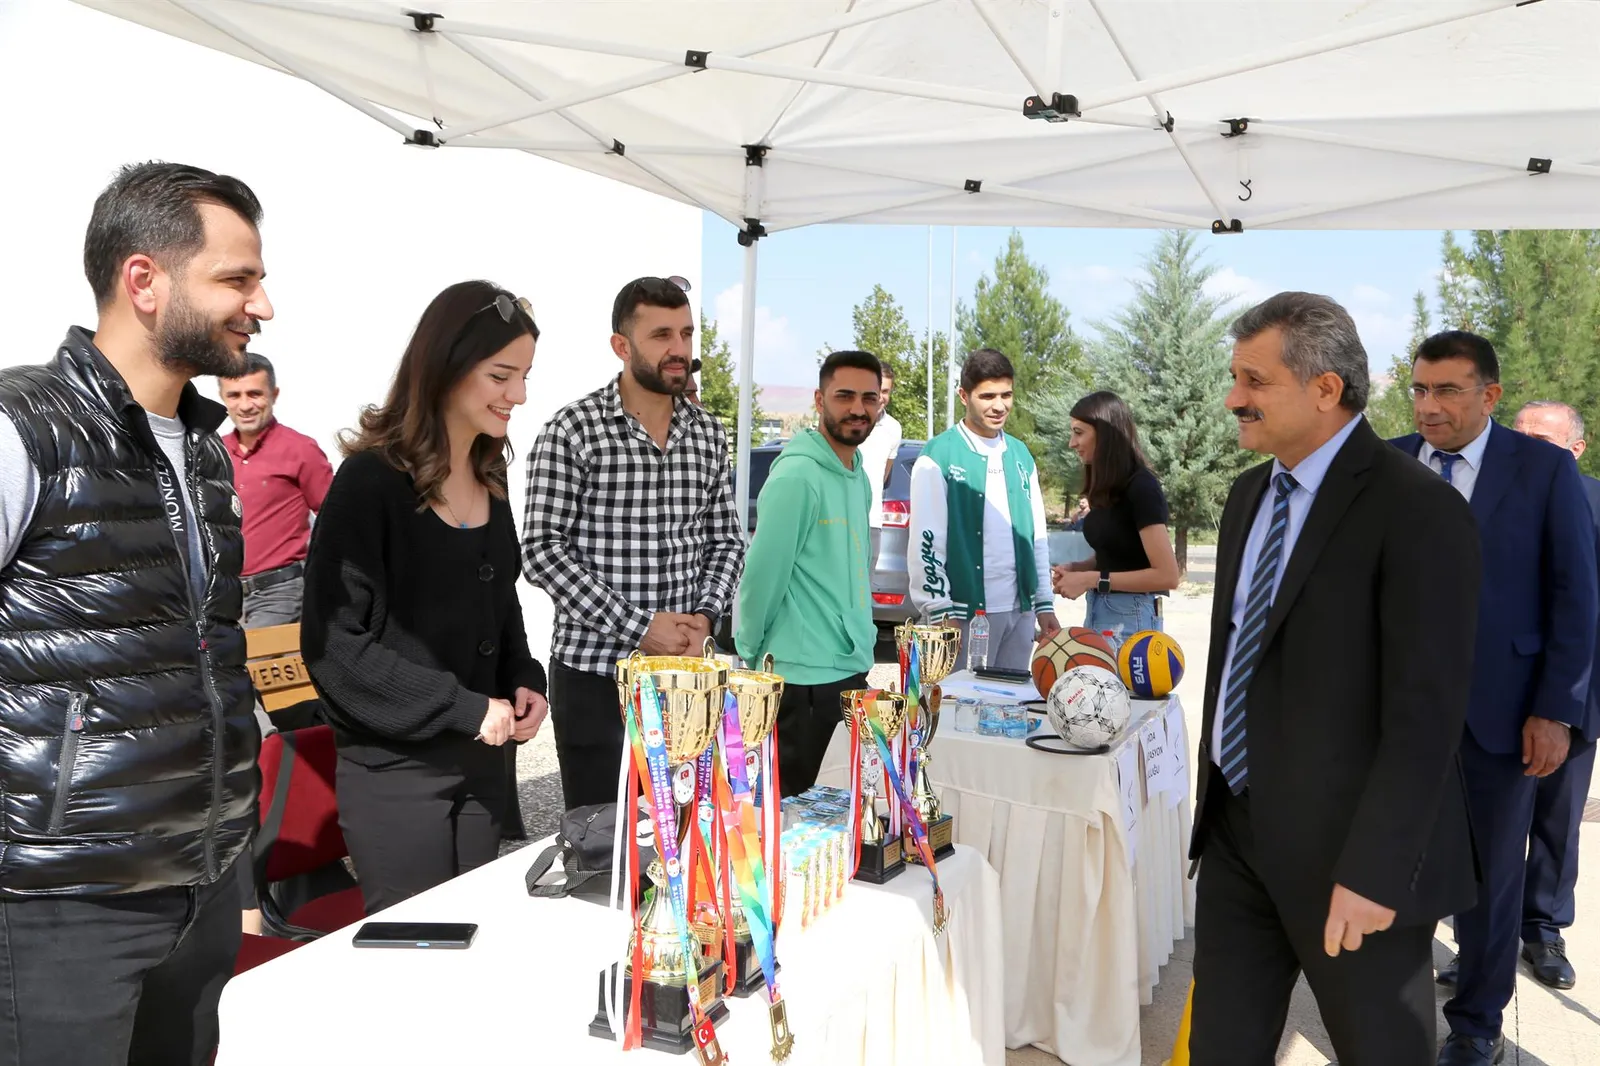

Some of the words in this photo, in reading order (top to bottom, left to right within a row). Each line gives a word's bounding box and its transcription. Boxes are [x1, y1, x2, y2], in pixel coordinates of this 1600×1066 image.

[922, 529, 946, 600] League
[1133, 656, 1145, 684] FIVB
[650, 756, 664, 810] UNIVERSITY
[658, 754, 672, 810] FEDERATION
